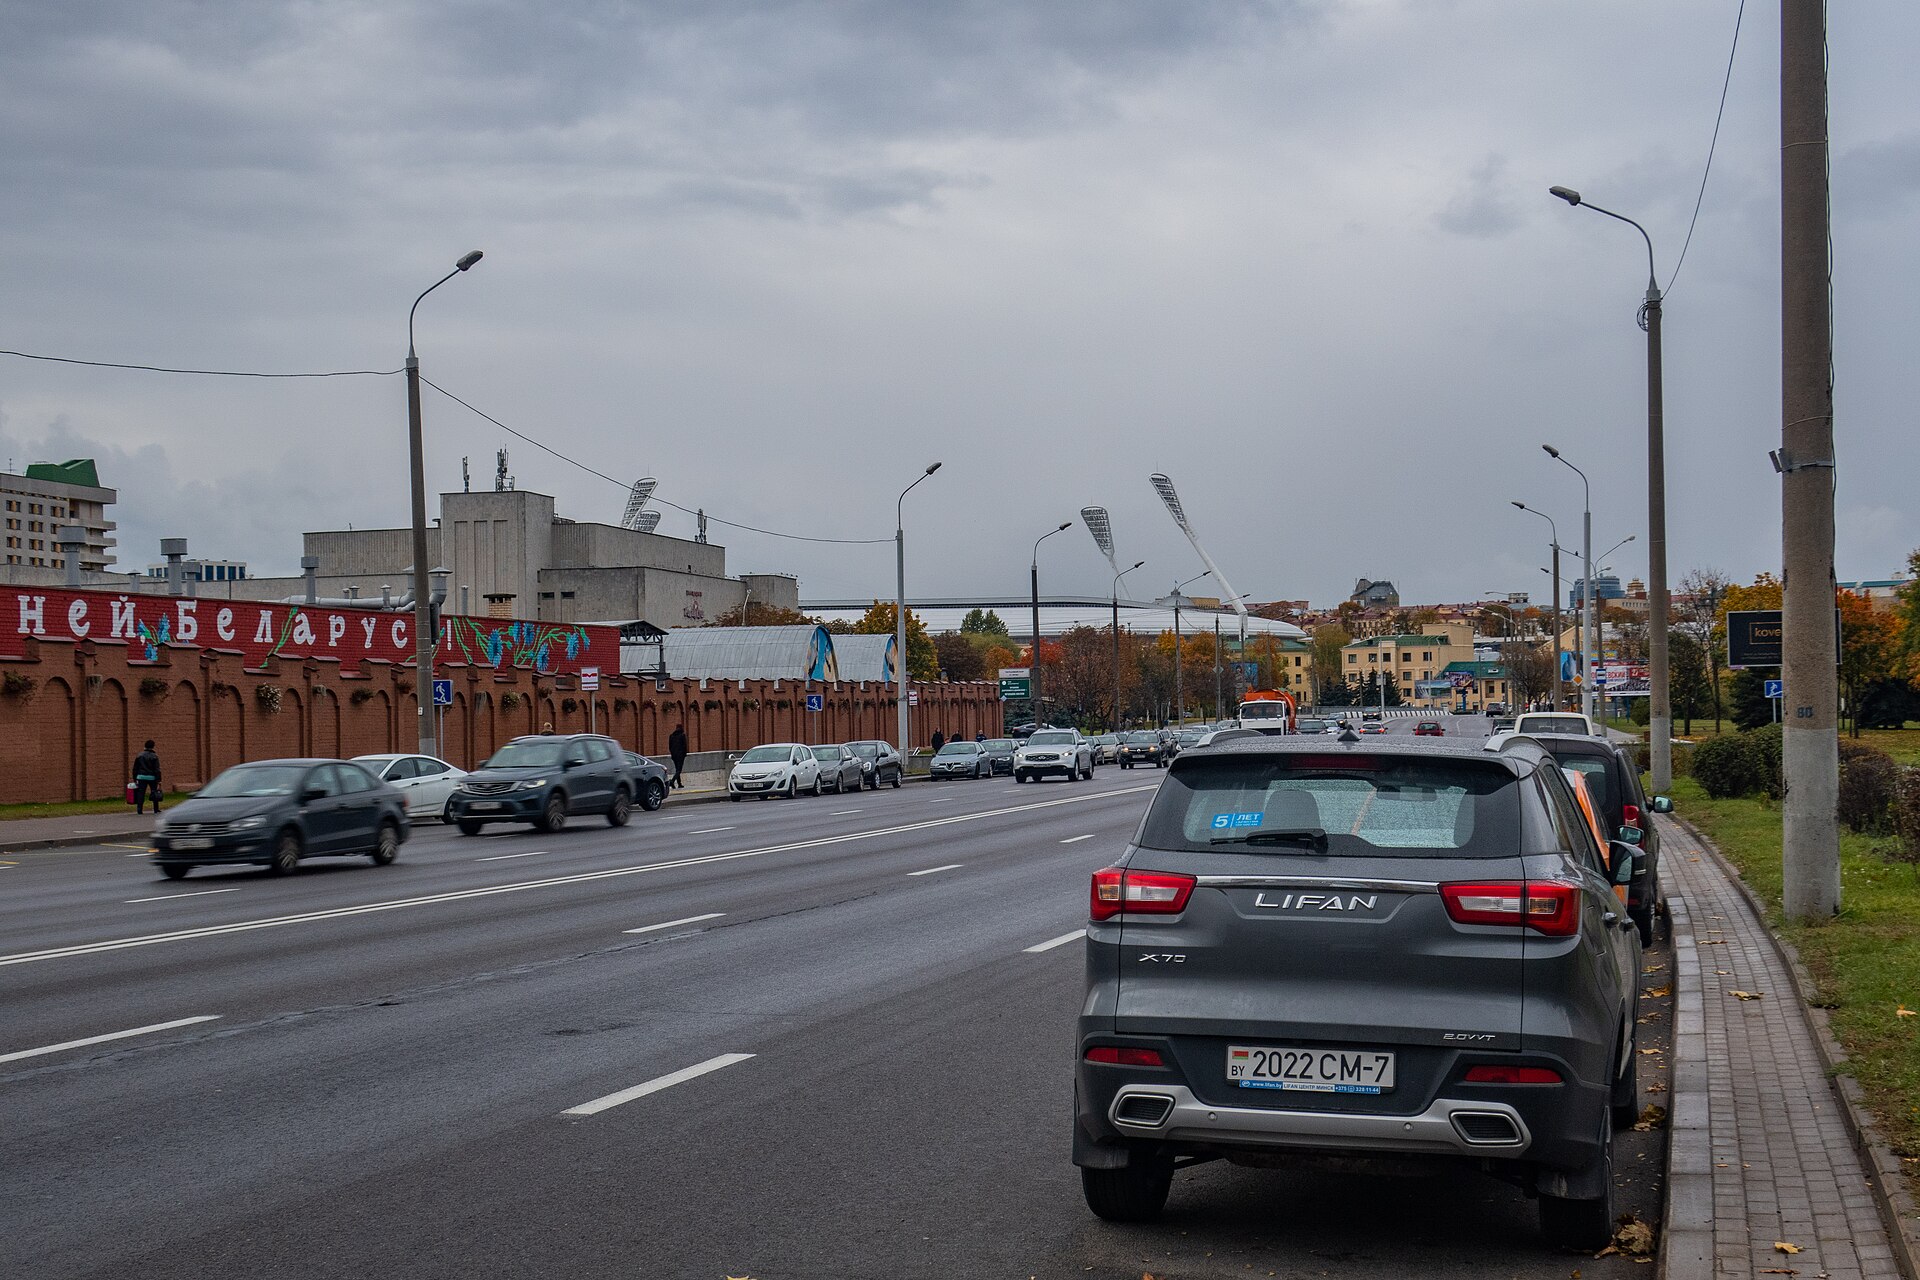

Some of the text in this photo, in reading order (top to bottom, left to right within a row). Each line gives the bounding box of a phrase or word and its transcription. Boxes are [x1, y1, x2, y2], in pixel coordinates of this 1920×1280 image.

[1215, 815, 1229, 828] 5
[1236, 813, 1260, 821] ЛЕТ
[1255, 893, 1378, 910] LIFAN
[1138, 953, 1187, 963] X70
[1231, 1050, 1390, 1083] BY 2022 CM-7
[1252, 1081, 1282, 1089] www.lifan.by
